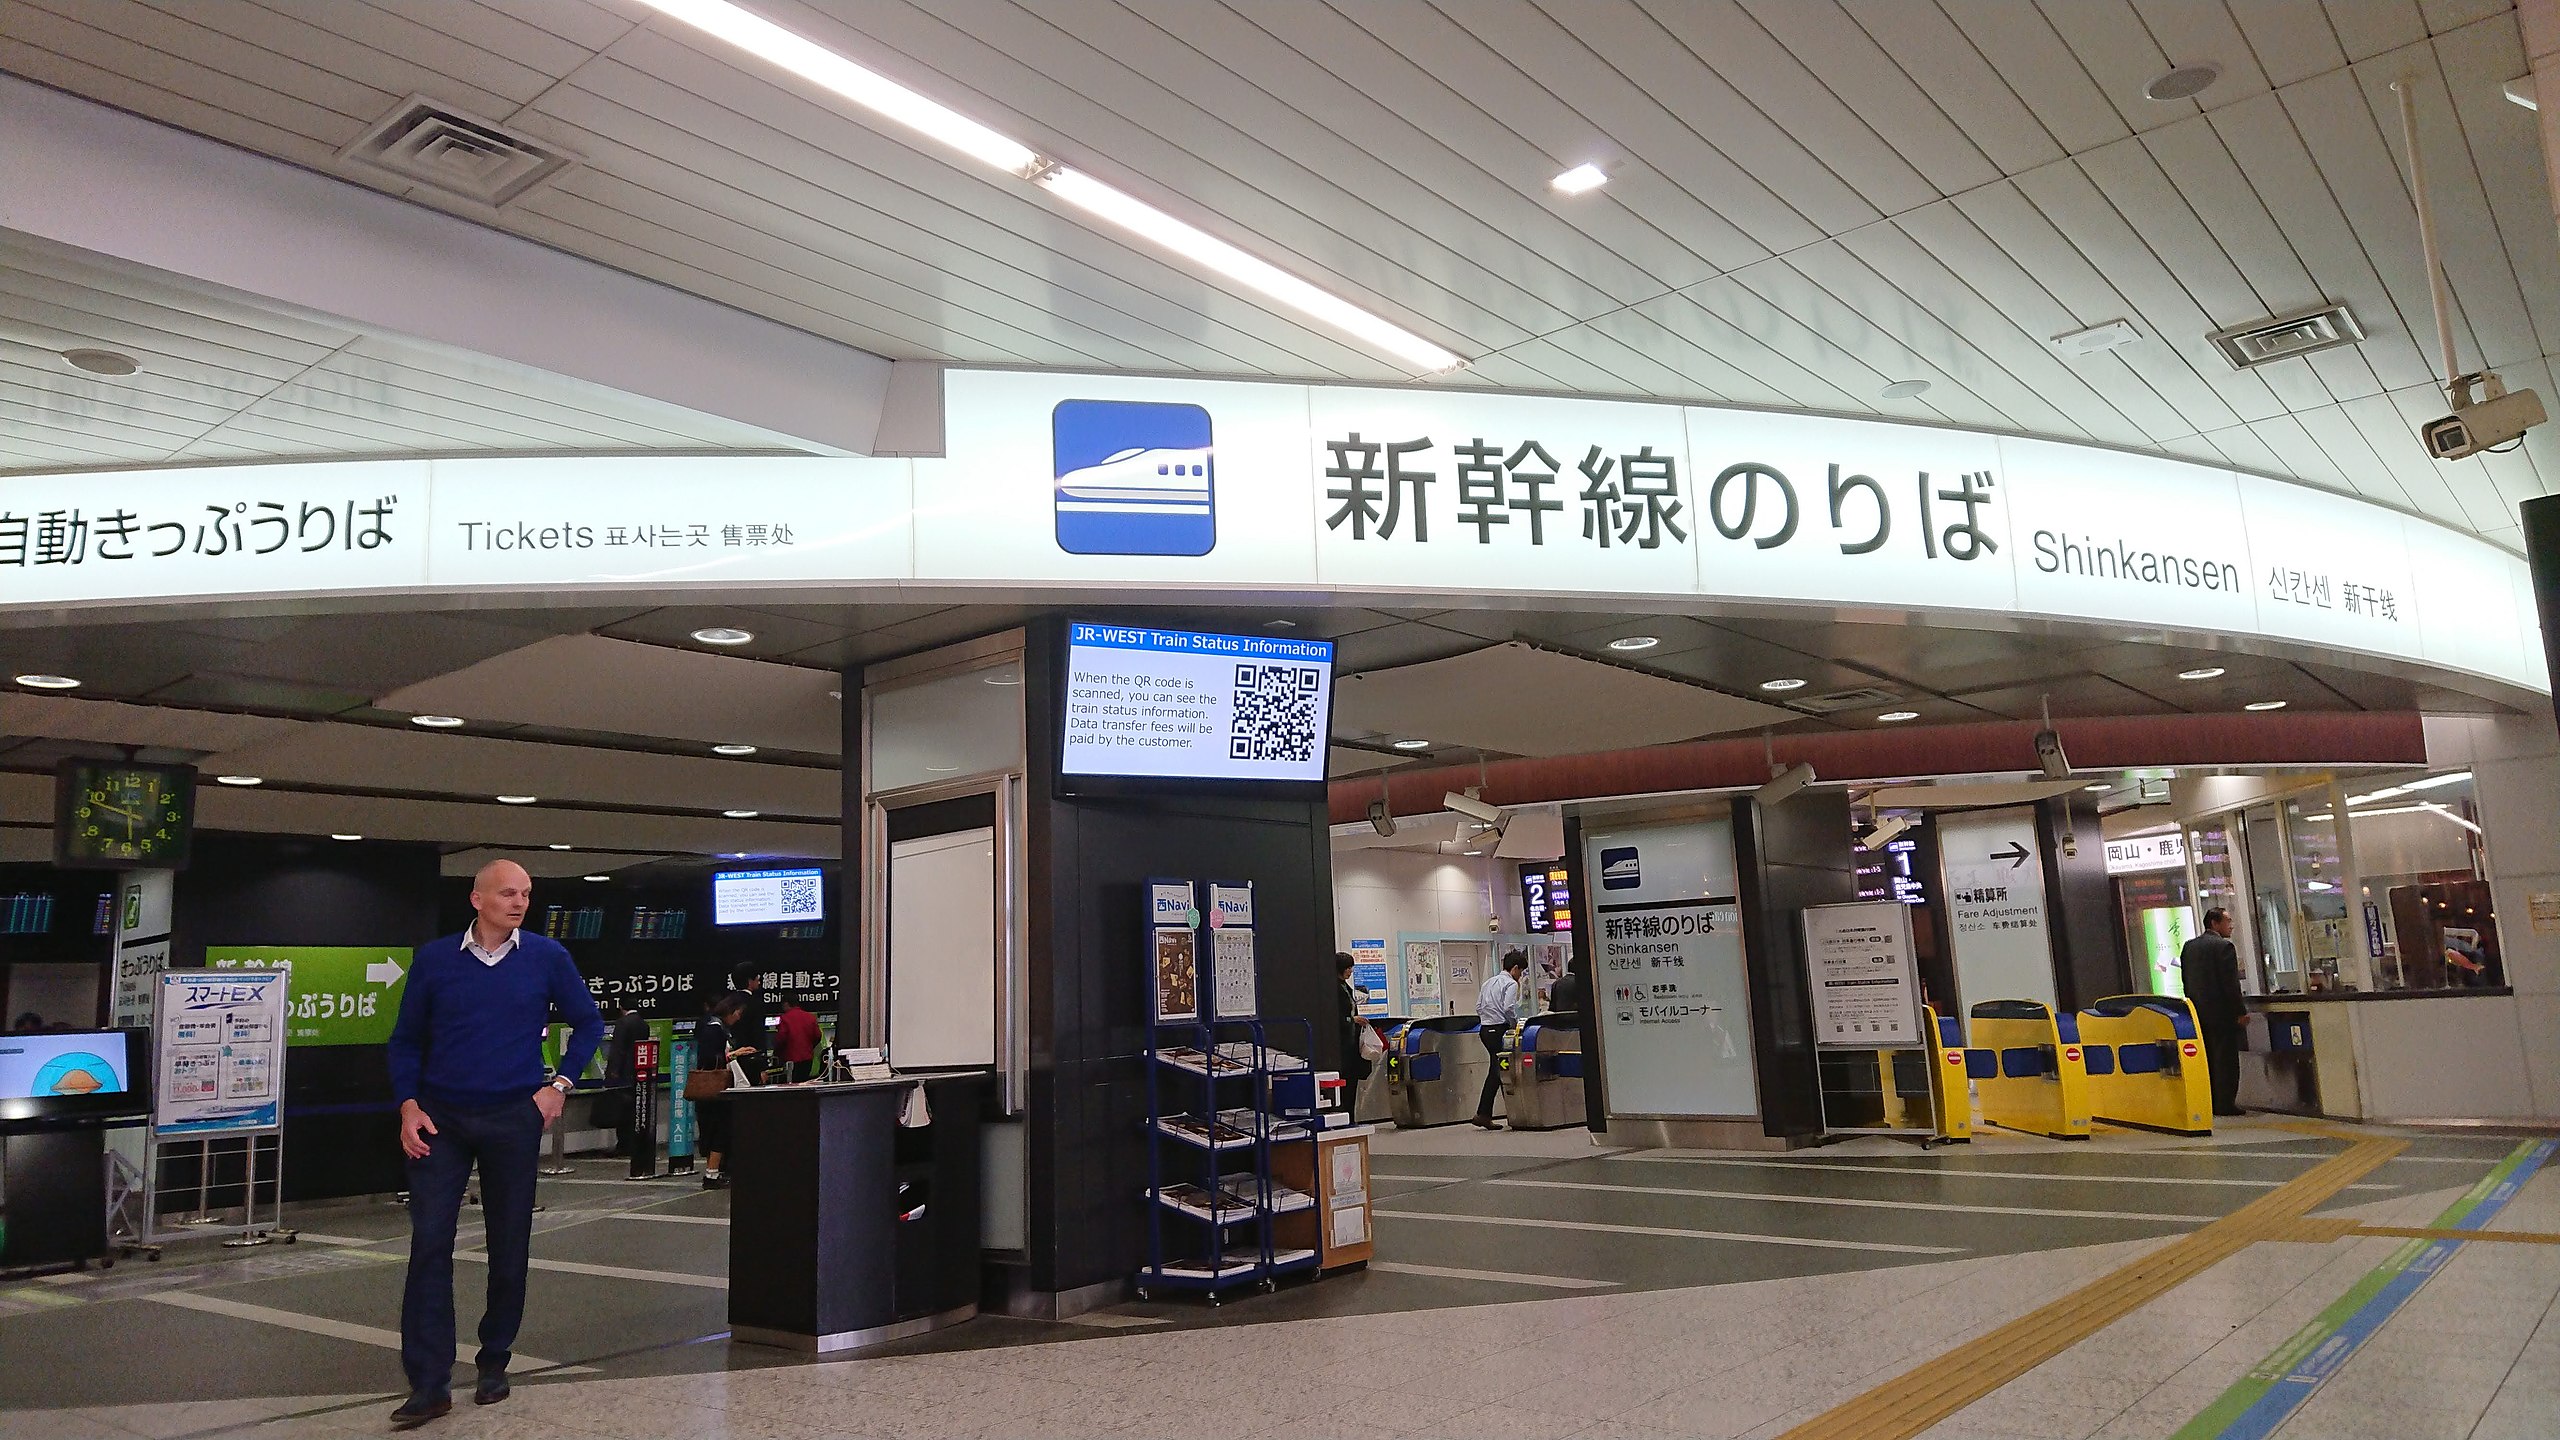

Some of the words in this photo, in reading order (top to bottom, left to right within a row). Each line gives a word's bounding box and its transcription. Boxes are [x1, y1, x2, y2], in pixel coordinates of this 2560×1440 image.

[1325, 431, 1998, 561] 新幹線のりば
[0, 494, 398, 568] 自動きっぷうりば
[458, 519, 595, 553] Tickets
[604, 523, 711, 550] 표사는곳
[720, 520, 795, 548] 售票处
[2033, 528, 2240, 595] Shinkansen
[2268, 564, 2332, 610] 신칸센
[2343, 579, 2399, 623] 新干线
[1075, 627, 1147, 645] JR-WEST
[1151, 632, 1188, 648] Train
[1192, 635, 1239, 651] Status
[1243, 638, 1328, 658] Information
[1073, 671, 1107, 685] When
[1111, 673, 1130, 685] the
[1134, 675, 1151, 688] QR
[1155, 675, 1181, 688] code
[1185, 677, 1194, 689] is
[1072, 688, 1124, 703] scanned,
[1128, 692, 1149, 704] you
[1153, 692, 1173, 703] can
[1177, 694, 1196, 704] see
[1199, 693, 1217, 705] the
[1071, 703, 1098, 715] train
[1102, 704, 1137, 716] status
[1141, 705, 1208, 719] information.
[1070, 717, 1098, 730] Data
[1102, 718, 1147, 731] transfer
[1151, 720, 1174, 733] fees
[1177, 721, 1195, 734] will
[1199, 722, 1213, 735] be
[1069, 733, 1094, 747] paid
[1098, 734, 1112, 747] by
[1116, 735, 1135, 746] the
[1138, 736, 1193, 748] customer.
[160, 793, 171, 804] 2
[166, 811, 177, 822] 3
[87, 825, 99, 837] 8
[156, 828, 166, 839] 4
[1896, 851, 1911, 876] 1
[1530, 884, 1545, 905] 2
[1973, 886, 2008, 904] 精算所
[1957, 910, 1980, 919] Fare
[1983, 906, 2039, 918] Adjustment
[1605, 911, 1715, 940] 新幹線のりば
[1607, 942, 1679, 956] Shinkansen
[1608, 957, 1642, 971] 신칸센
[1650, 955, 1685, 968] 新干线
[580, 973, 695, 995] きっぷうりば
[727, 971, 840, 991] 線自動きっ
[185, 986, 266, 1002] スマートEX
[763, 992, 829, 1003] Shinsen
[1639, 1004, 1722, 1017] モバイルコーナー
[637, 1045, 648, 1066] 出口
[673, 1122, 683, 1143] 入口
